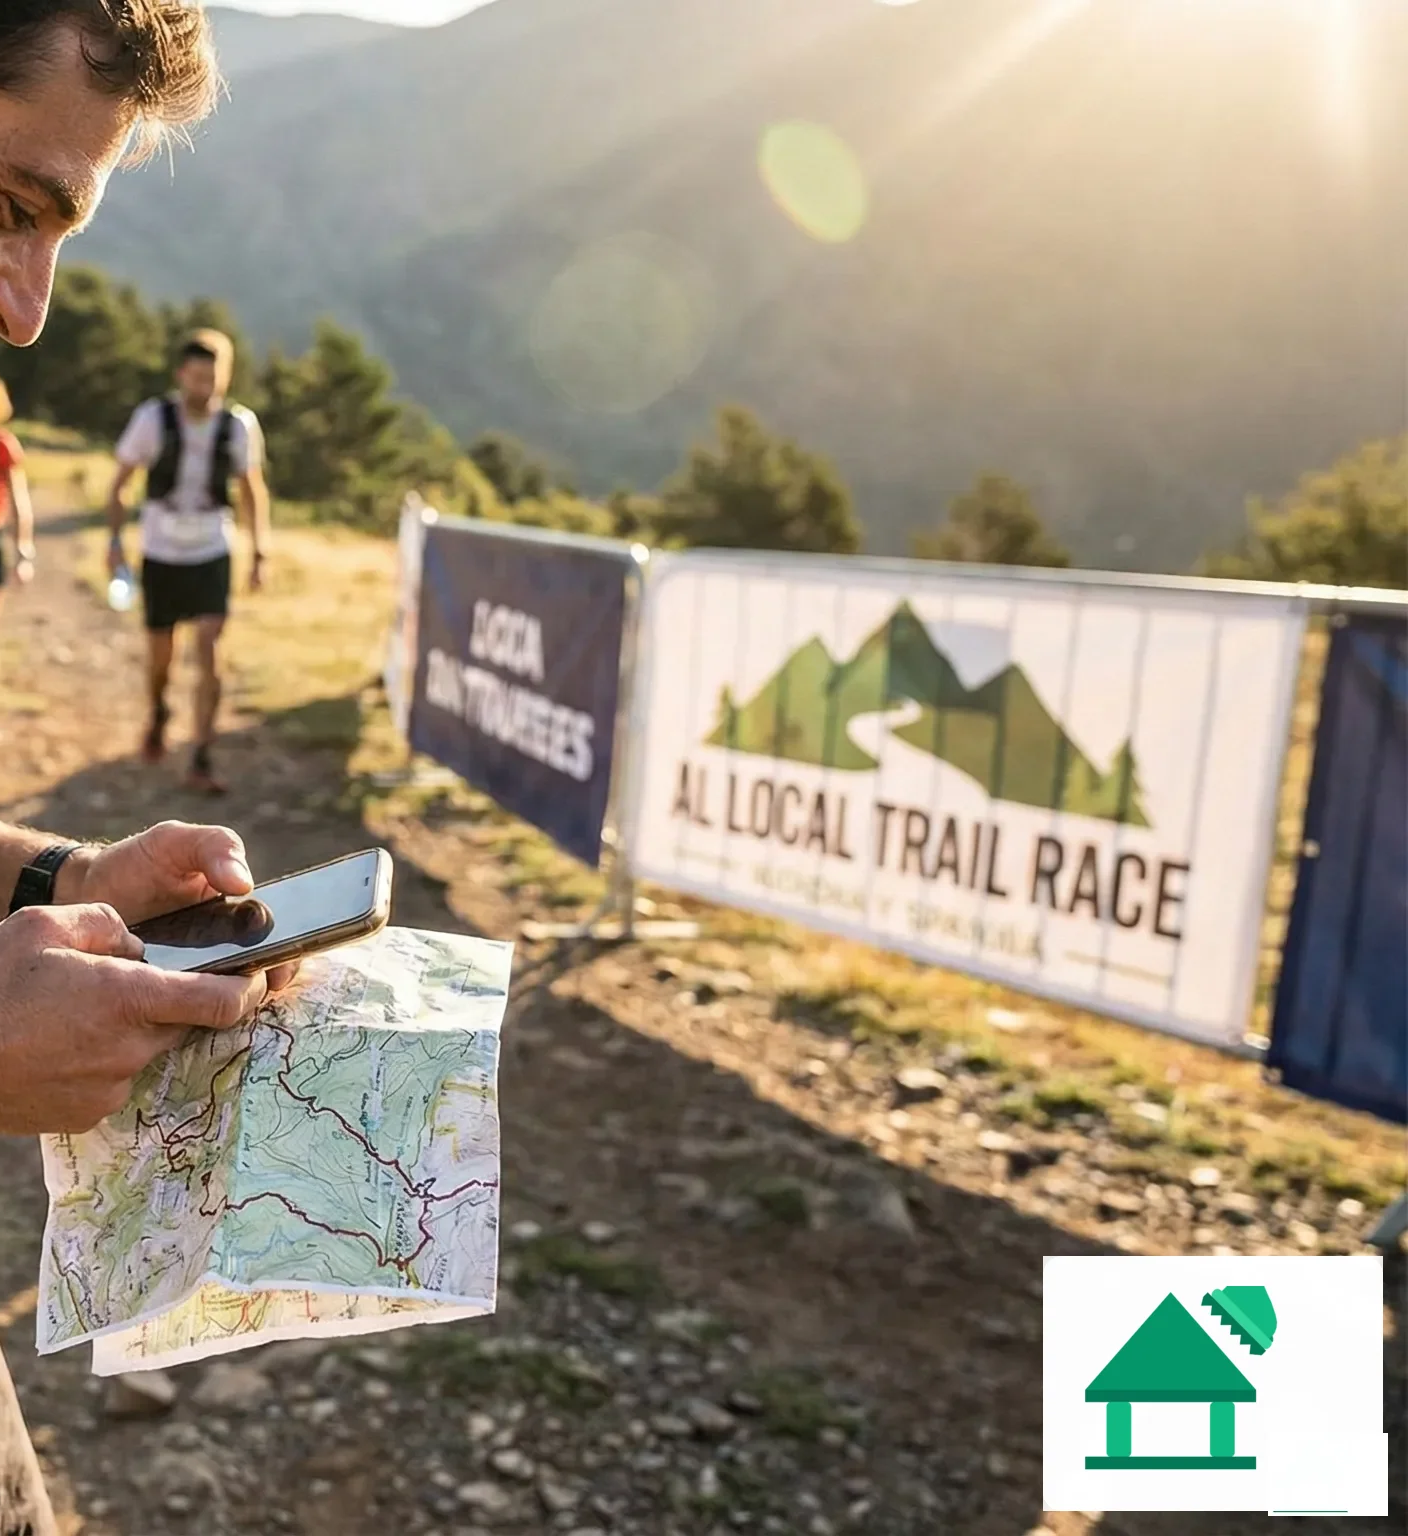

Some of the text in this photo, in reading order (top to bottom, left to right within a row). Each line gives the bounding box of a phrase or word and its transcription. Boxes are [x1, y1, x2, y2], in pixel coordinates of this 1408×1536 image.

[727, 773, 853, 860] LOCAL
[876, 802, 1008, 897] TRAIL
[1030, 836, 1192, 941] RACE
